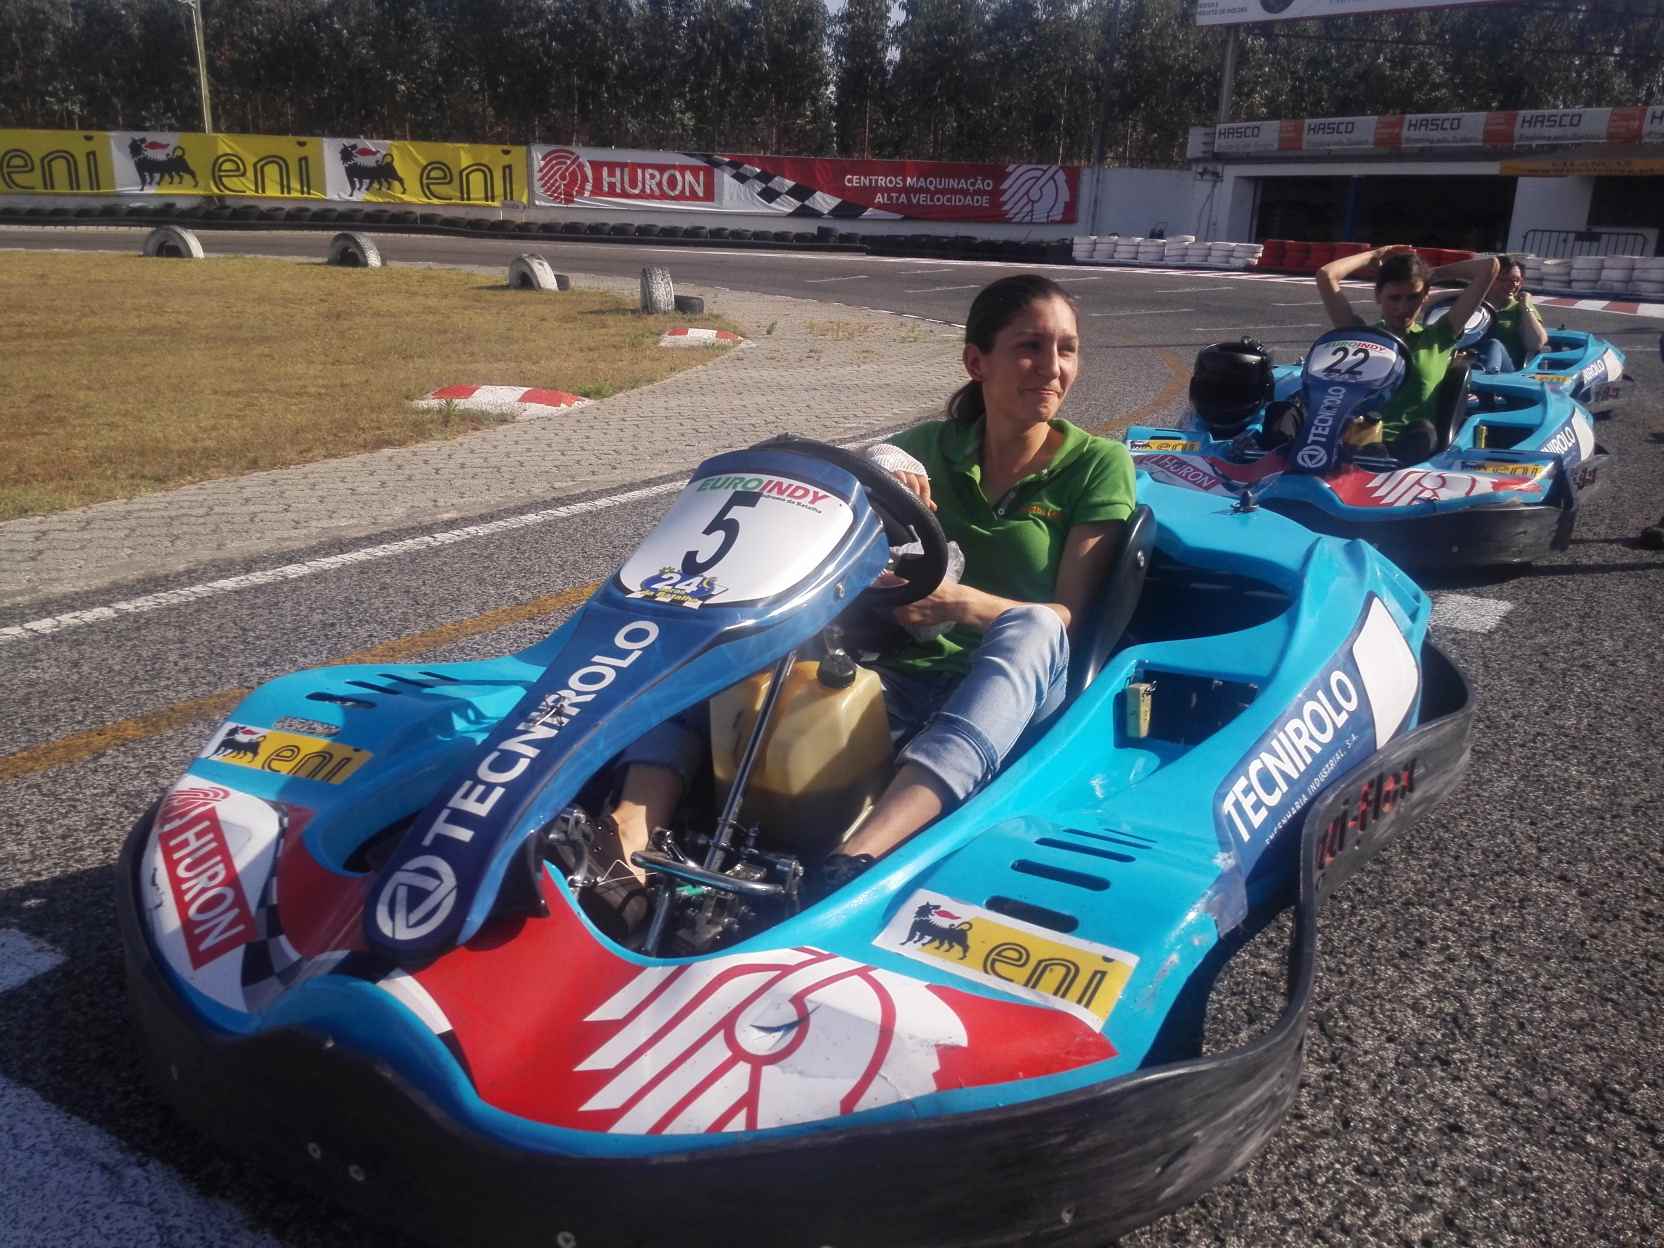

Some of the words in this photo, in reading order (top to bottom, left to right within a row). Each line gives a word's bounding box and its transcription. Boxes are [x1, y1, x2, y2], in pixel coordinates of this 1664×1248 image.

[1217, 126, 1260, 139] HASCO
[1306, 121, 1354, 136] HASCO
[1407, 118, 1462, 132] HASCO
[1520, 113, 1583, 128] HASCO
[0, 135, 98, 191] eni
[210, 141, 311, 195] eni
[418, 149, 513, 201] eni
[602, 166, 704, 197] HURON
[844, 175, 903, 188] CENTROS
[906, 176, 993, 192] MAQUINAÇÃO
[873, 192, 907, 205] ALTA
[910, 193, 990, 207] VELOCIDADE
[1321, 346, 1370, 377] 22
[1540, 426, 1575, 454] NIROLO
[1159, 456, 1217, 488] HURON
[697, 476, 829, 505] EUROINDY
[681, 490, 764, 577] 5
[650, 572, 704, 594] 24
[422, 620, 660, 847] TECNIROLO
[262, 744, 362, 784] eni
[1222, 670, 1359, 843] TECNIROLO
[168, 820, 246, 952] HURON
[982, 941, 1115, 1010] eni
